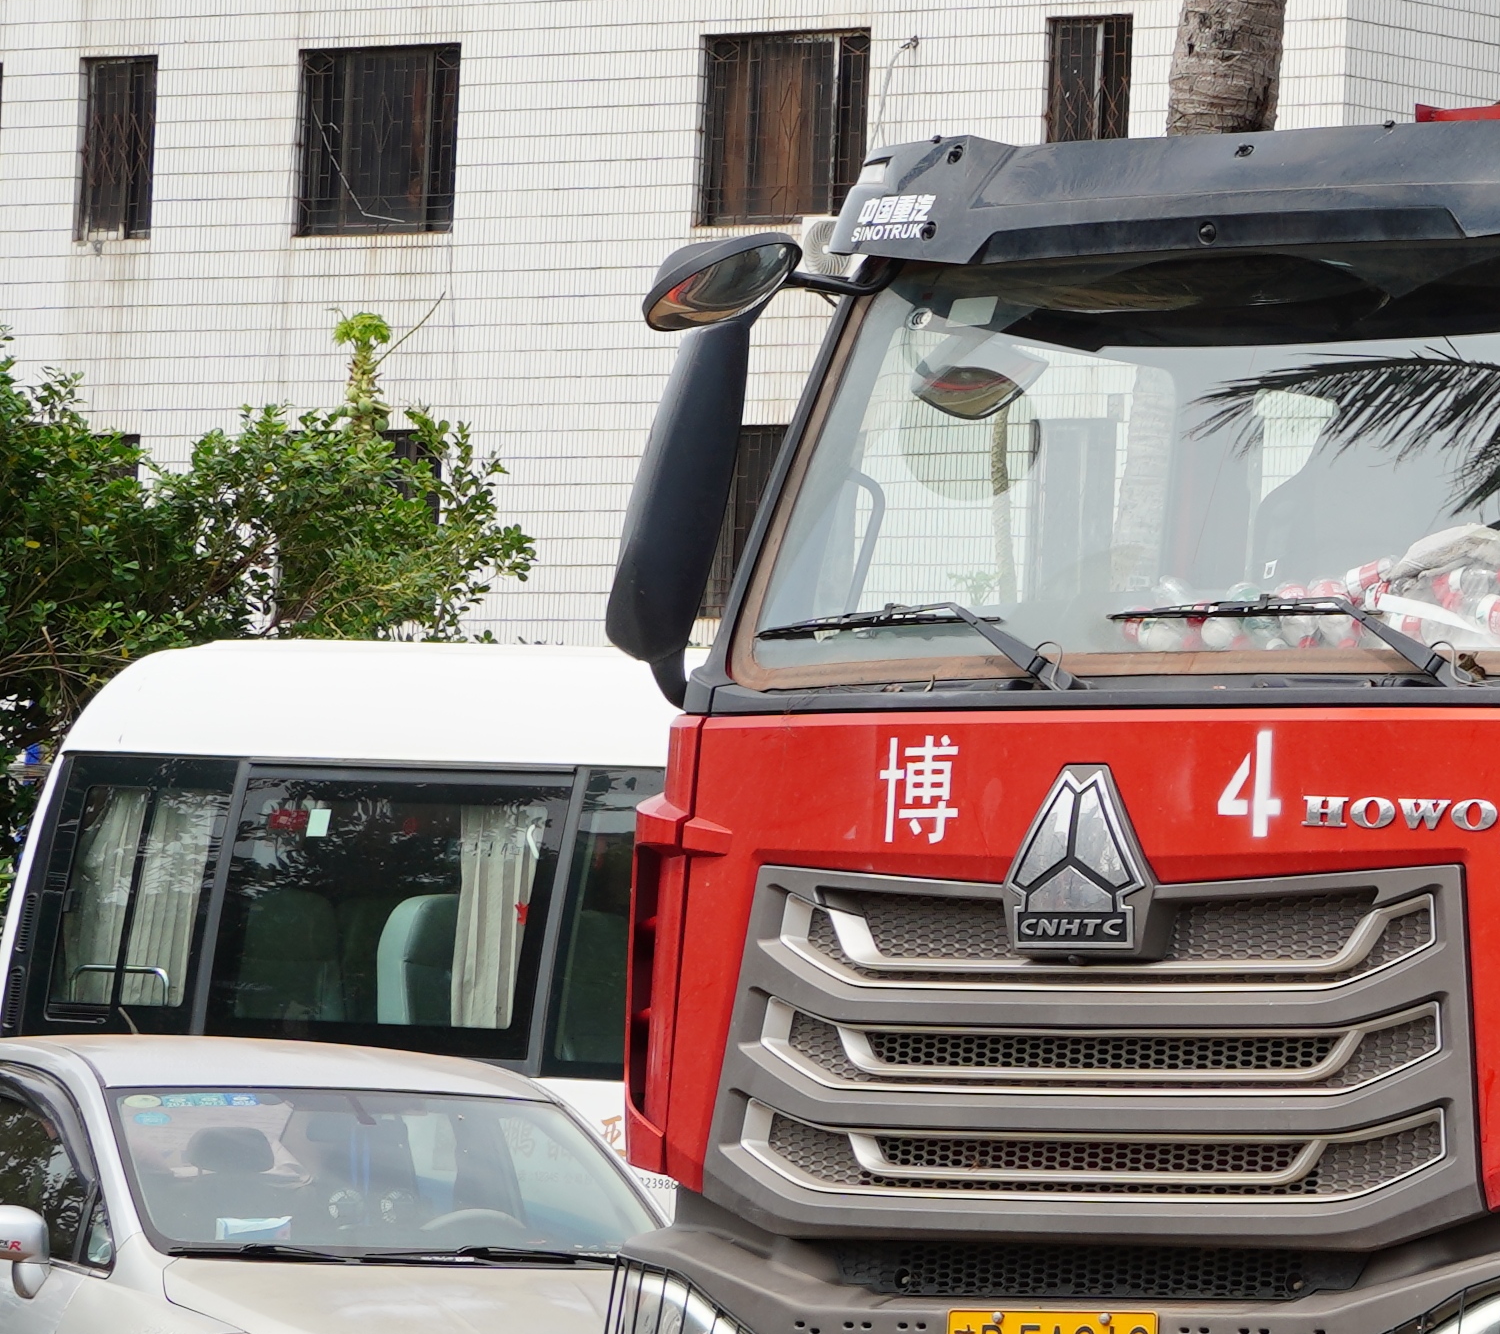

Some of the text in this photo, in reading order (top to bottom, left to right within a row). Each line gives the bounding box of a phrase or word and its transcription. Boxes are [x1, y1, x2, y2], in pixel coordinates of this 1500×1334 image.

[857, 194, 937, 225] 中国重汽
[851, 222, 925, 242] SINOTRUK
[878, 734, 959, 845] 博
[1217, 729, 1282, 838] 4
[1301, 794, 1499, 831] HOWO
[1020, 917, 1125, 938] CNHTC
